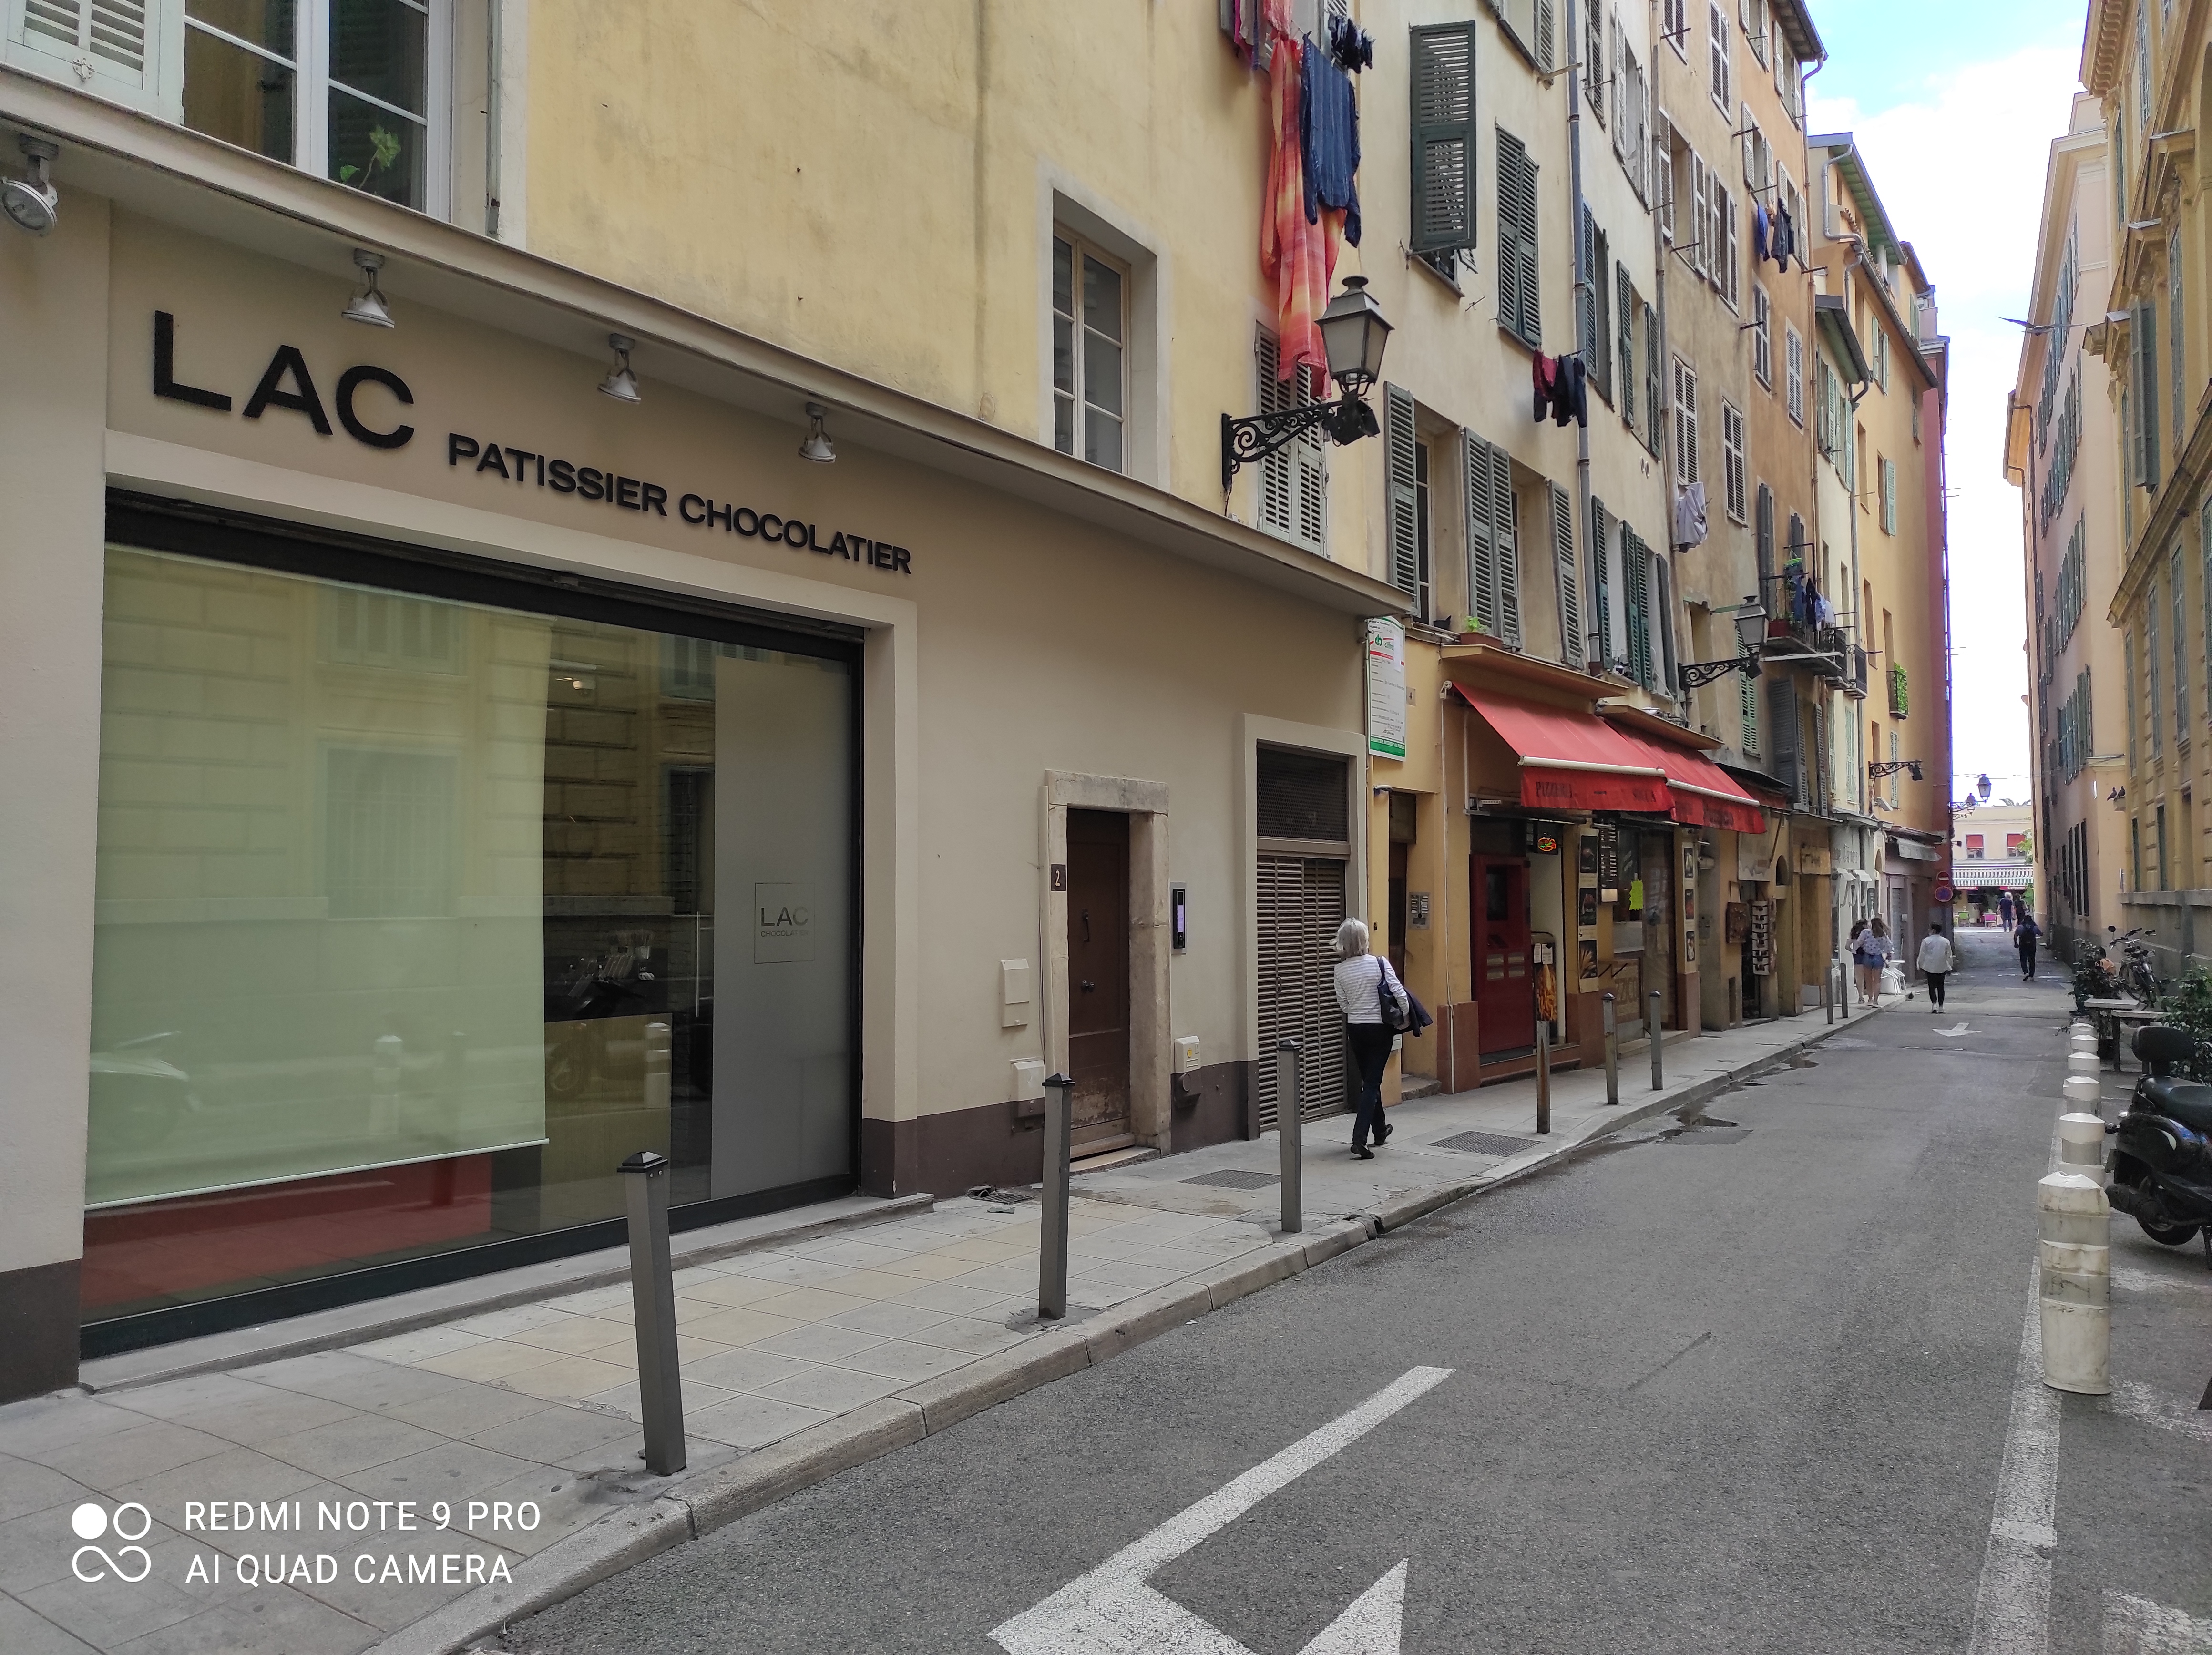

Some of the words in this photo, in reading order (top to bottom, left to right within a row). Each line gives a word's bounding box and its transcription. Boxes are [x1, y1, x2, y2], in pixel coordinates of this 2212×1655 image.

[154, 310, 415, 450] LAC
[448, 432, 668, 517] PATISSIER
[679, 493, 911, 574] CHOCOLATIER
[1055, 870, 1060, 886] 2
[761, 906, 809, 927] LAC
[760, 929, 809, 937] CHOCOLATIER
